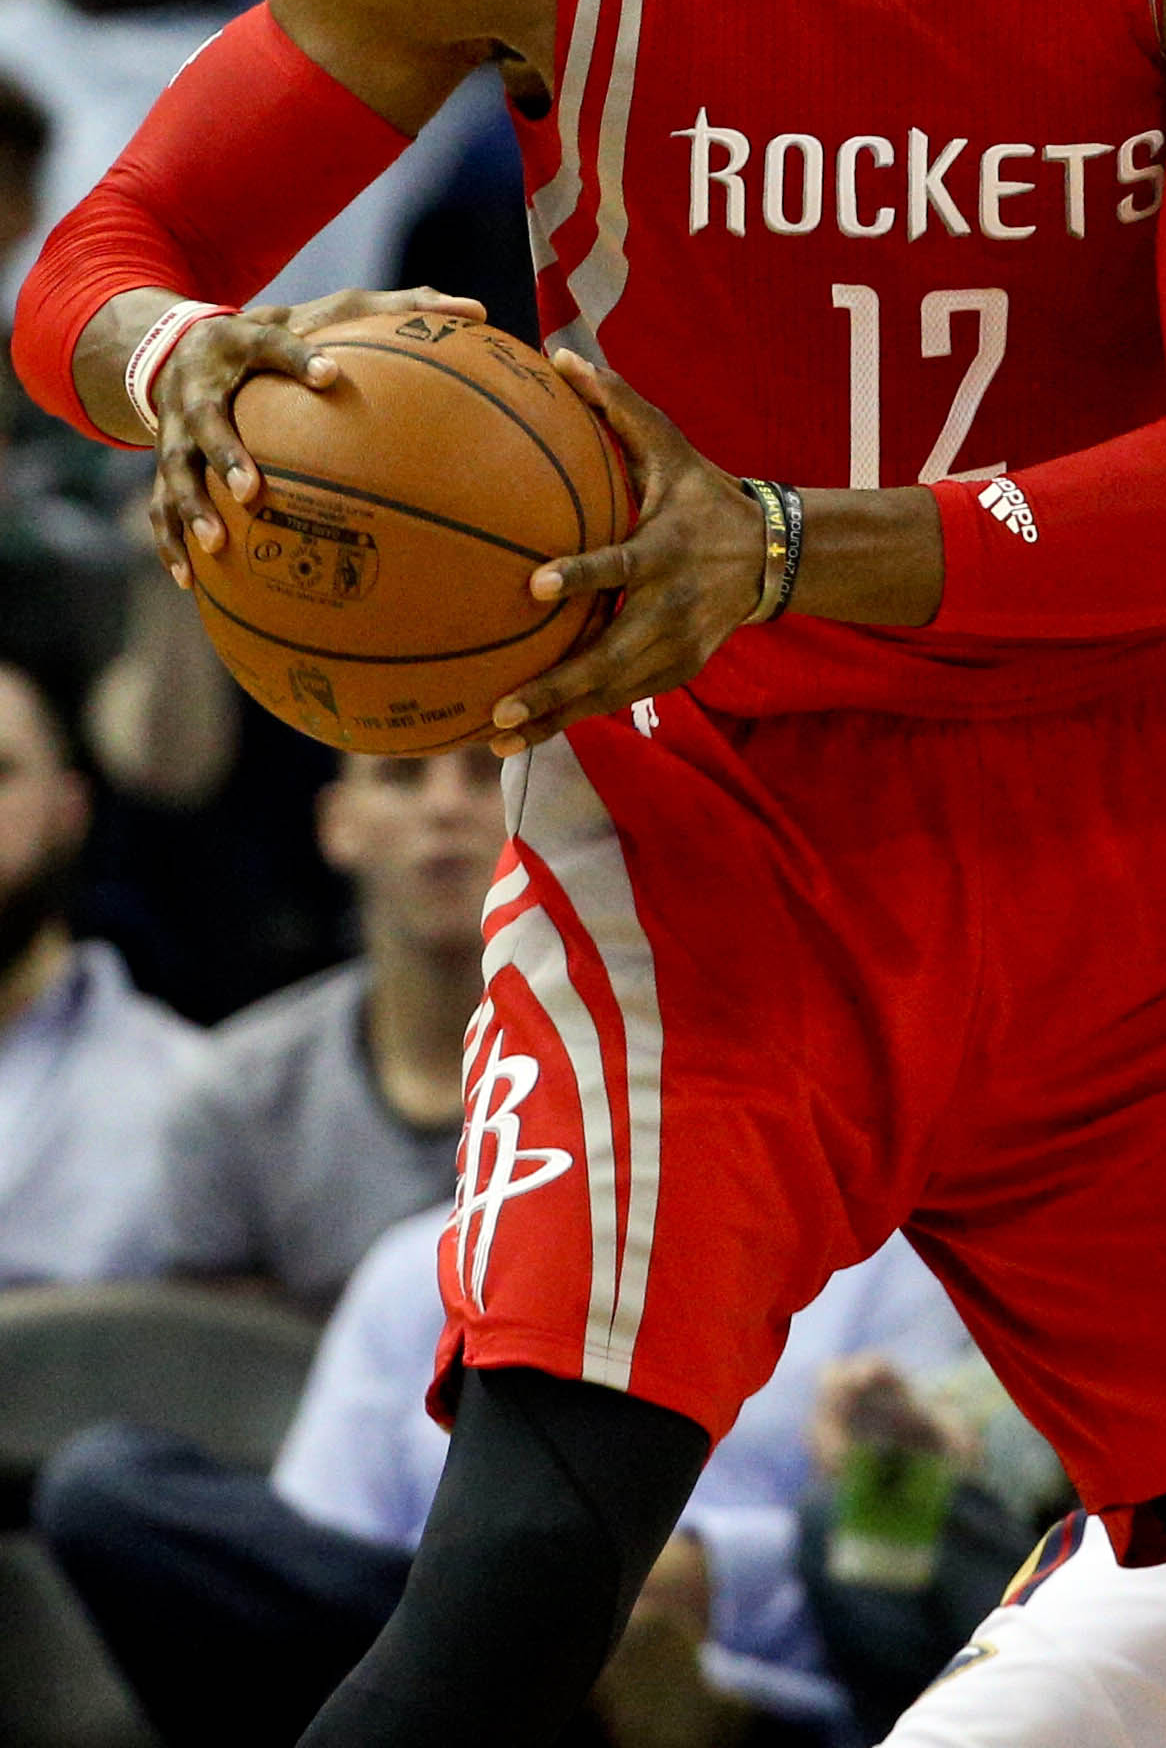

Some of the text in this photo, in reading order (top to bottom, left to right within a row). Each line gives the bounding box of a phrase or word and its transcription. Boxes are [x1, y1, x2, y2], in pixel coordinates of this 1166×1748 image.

[669, 105, 1166, 243] ROCKETS
[831, 282, 1010, 492] 12
[759, 485, 786, 531] JAMES
